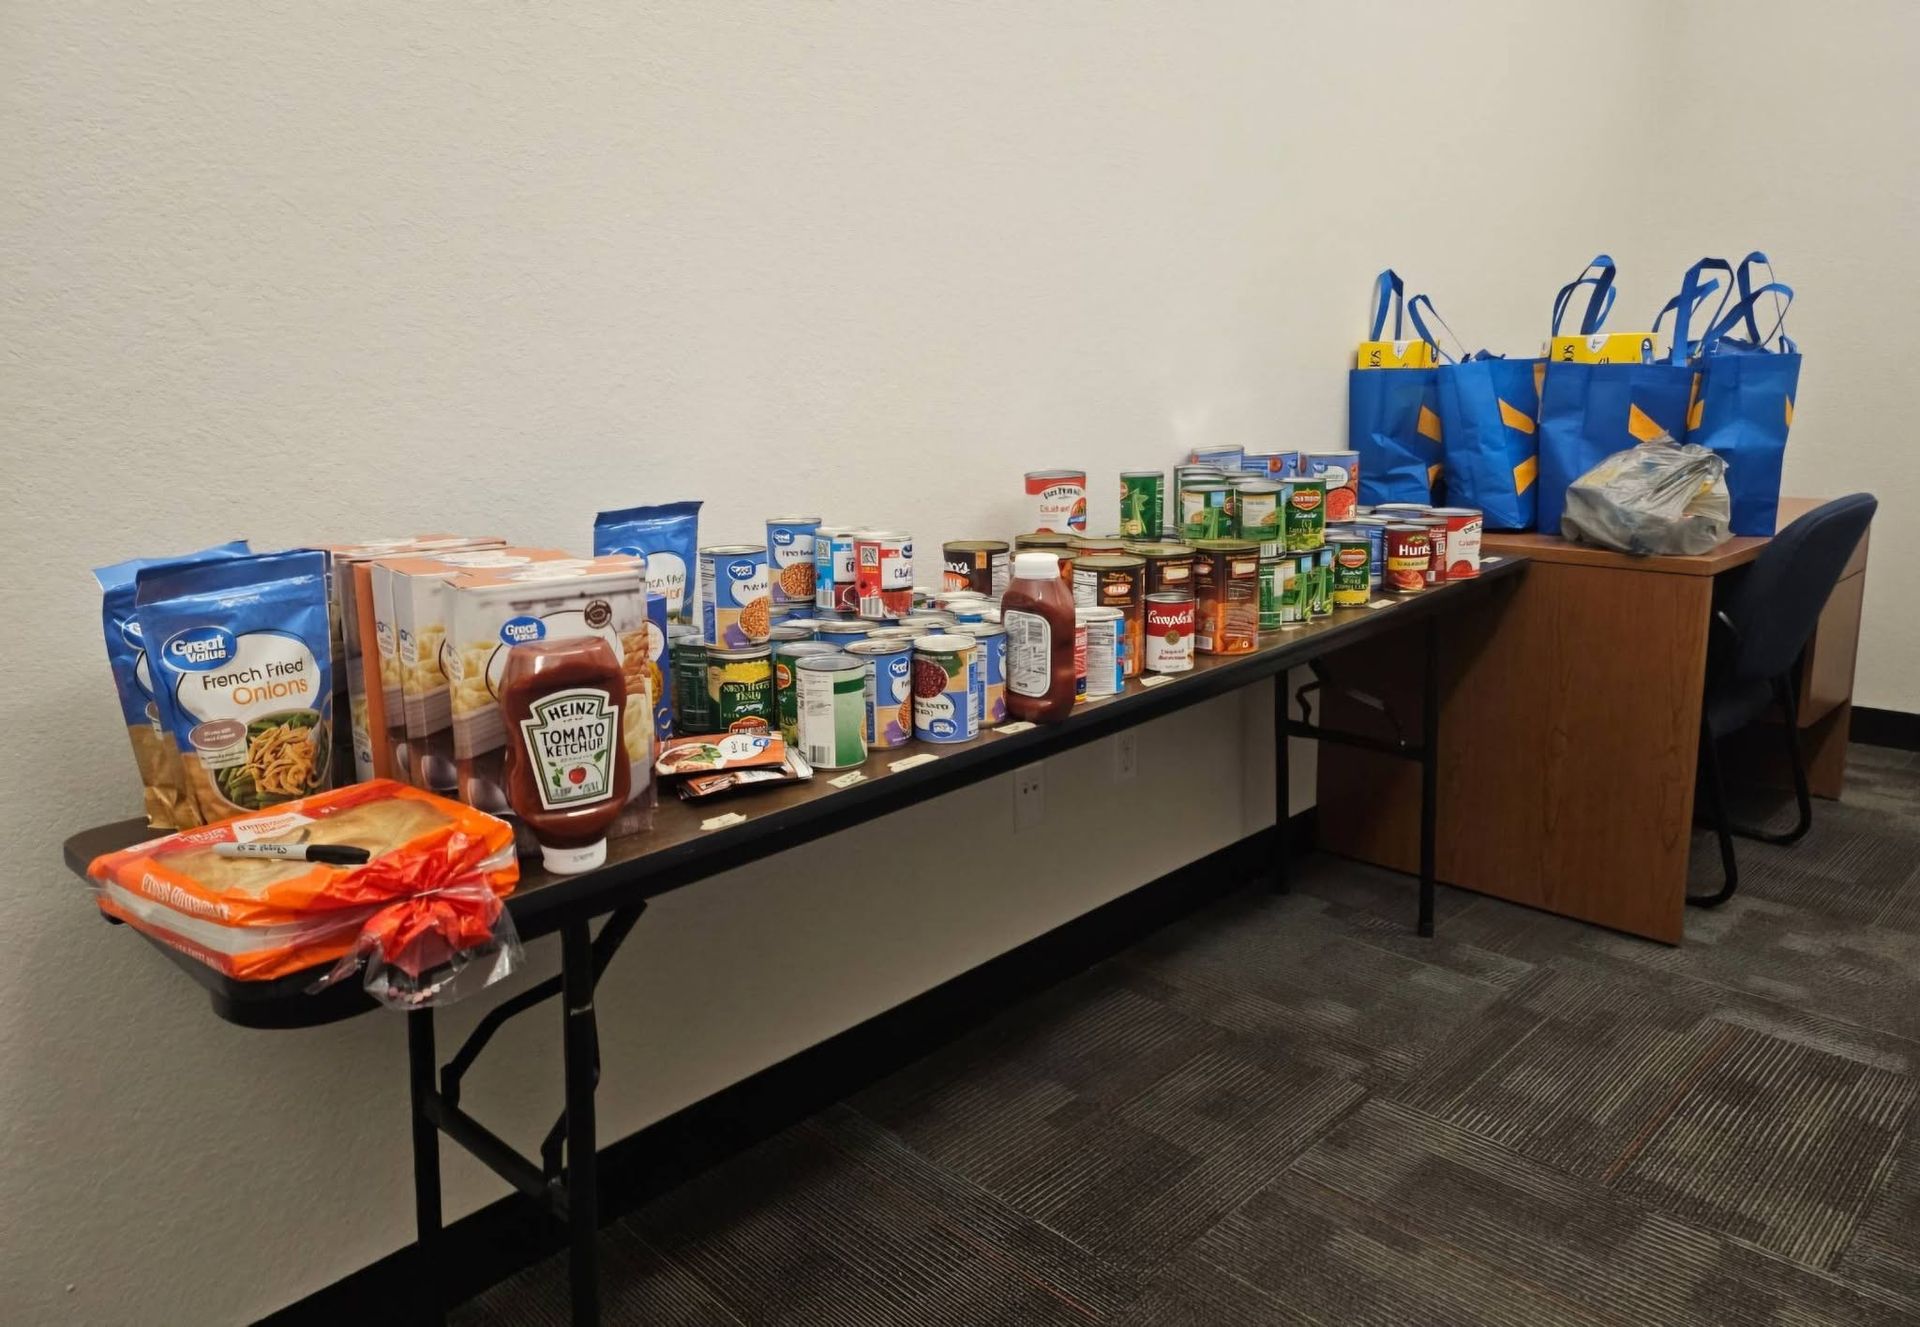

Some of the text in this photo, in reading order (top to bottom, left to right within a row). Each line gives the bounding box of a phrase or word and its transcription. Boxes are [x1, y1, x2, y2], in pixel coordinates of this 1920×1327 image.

[504, 621, 538, 637] Great
[170, 634, 226, 656] Great
[186, 648, 227, 664] Value
[201, 658, 304, 691] French Fried
[232, 675, 308, 706] Onions
[548, 702, 597, 721] HEINZ
[540, 722, 606, 746] TOMATO
[545, 737, 604, 758] KETCHUP
